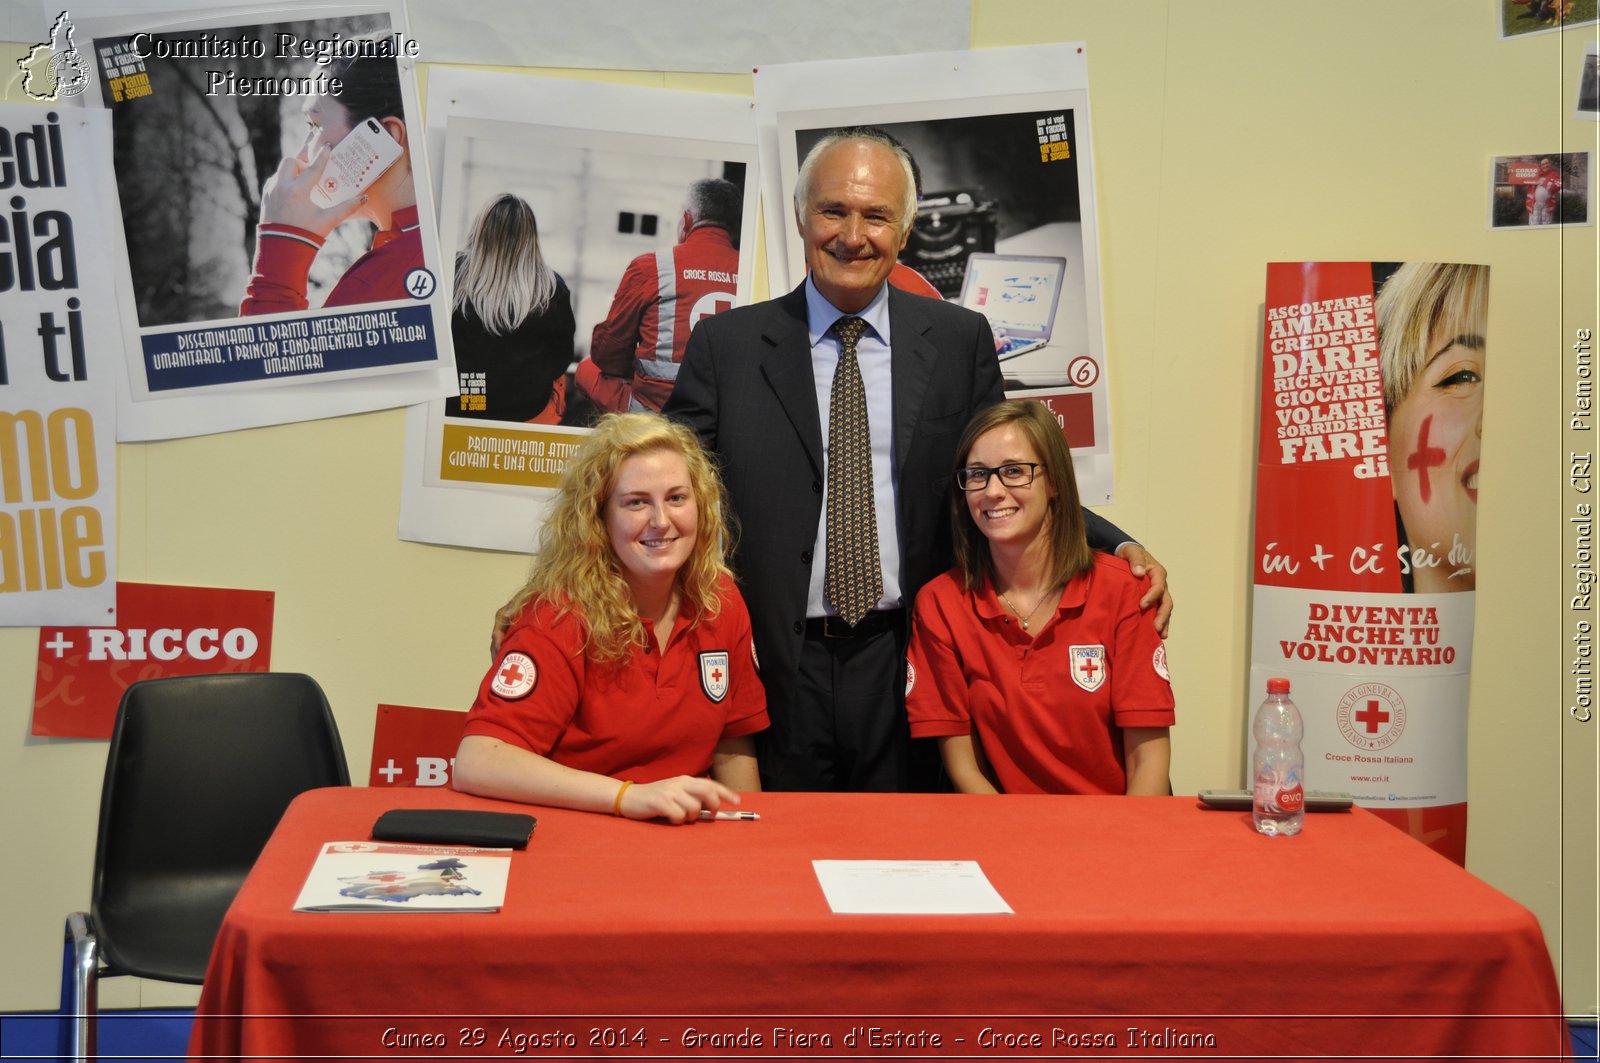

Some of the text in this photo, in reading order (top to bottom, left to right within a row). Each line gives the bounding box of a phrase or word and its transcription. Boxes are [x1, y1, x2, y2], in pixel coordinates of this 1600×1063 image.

[106, 61, 146, 79] ma non ti
[110, 73, 149, 90] giriamo
[1040, 141, 1068, 154] giriamo
[683, 270, 706, 280] CROCE
[708, 271, 731, 283] ROSSA
[1268, 294, 1372, 321] ASCOLTARE
[178, 312, 398, 350] DISSEMINIAMO IL DIRITTO INTERNAZIONALE
[1269, 308, 1374, 339] AMARE
[38, 297, 88, 382] ti
[153, 325, 426, 370] UMANITARIO, I PRINCIPI FONDAMENTALI ED I VALORI
[1270, 327, 1375, 354] CREDERE
[264, 353, 324, 374] UMANITARI
[1272, 343, 1378, 379] DARE
[1274, 367, 1379, 392] RICEVERE
[1274, 381, 1381, 408] GIOCARE
[1276, 398, 1384, 426] VOLARE
[1277, 416, 1384, 438] SORRIDERE
[468, 436, 544, 456] PROMUOVIAMO
[1280, 428, 1386, 464] FARE
[449, 451, 489, 468] GIOVANI
[492, 454, 500, 469] E
[504, 455, 525, 472] UNA
[1353, 456, 1390, 479] di
[1262, 542, 1299, 574] in
[1350, 543, 1384, 574] ci
[1396, 542, 1441, 574] sei
[1308, 603, 1438, 625] DIVENTA
[88, 627, 259, 661] RICCO
[1304, 624, 1440, 645] ANCHE TU
[1077, 649, 1099, 658] PIONIERI
[1279, 640, 1455, 665] VOLONTARIO
[1358, 685, 1392, 698] GINEVRA
[1325, 753, 1351, 762] Croce
[1354, 755, 1382, 763] Rossa
